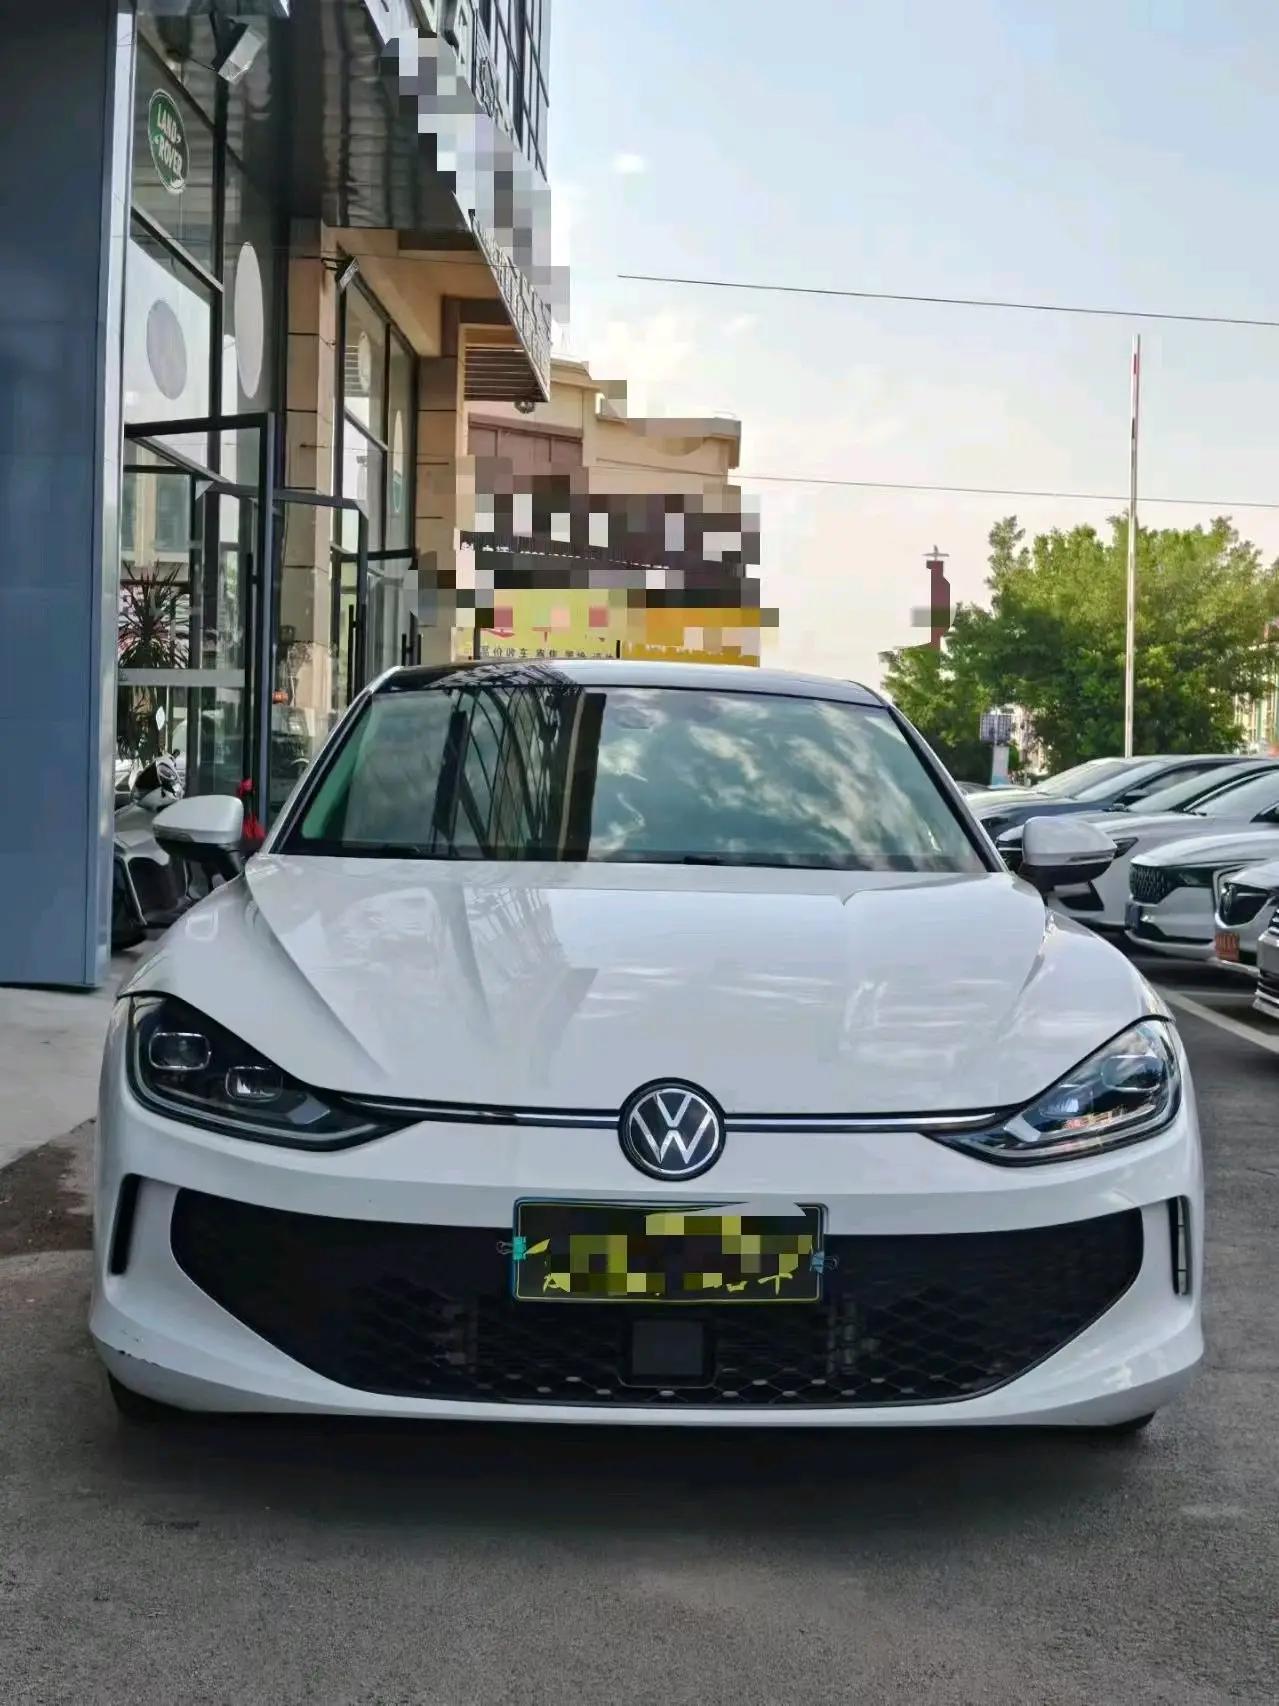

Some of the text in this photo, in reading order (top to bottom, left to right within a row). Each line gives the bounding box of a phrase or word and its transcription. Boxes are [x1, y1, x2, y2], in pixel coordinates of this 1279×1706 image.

[157, 103, 177, 143] LAND
[157, 133, 183, 178] ROVER
[630, 1092, 716, 1167] VW
